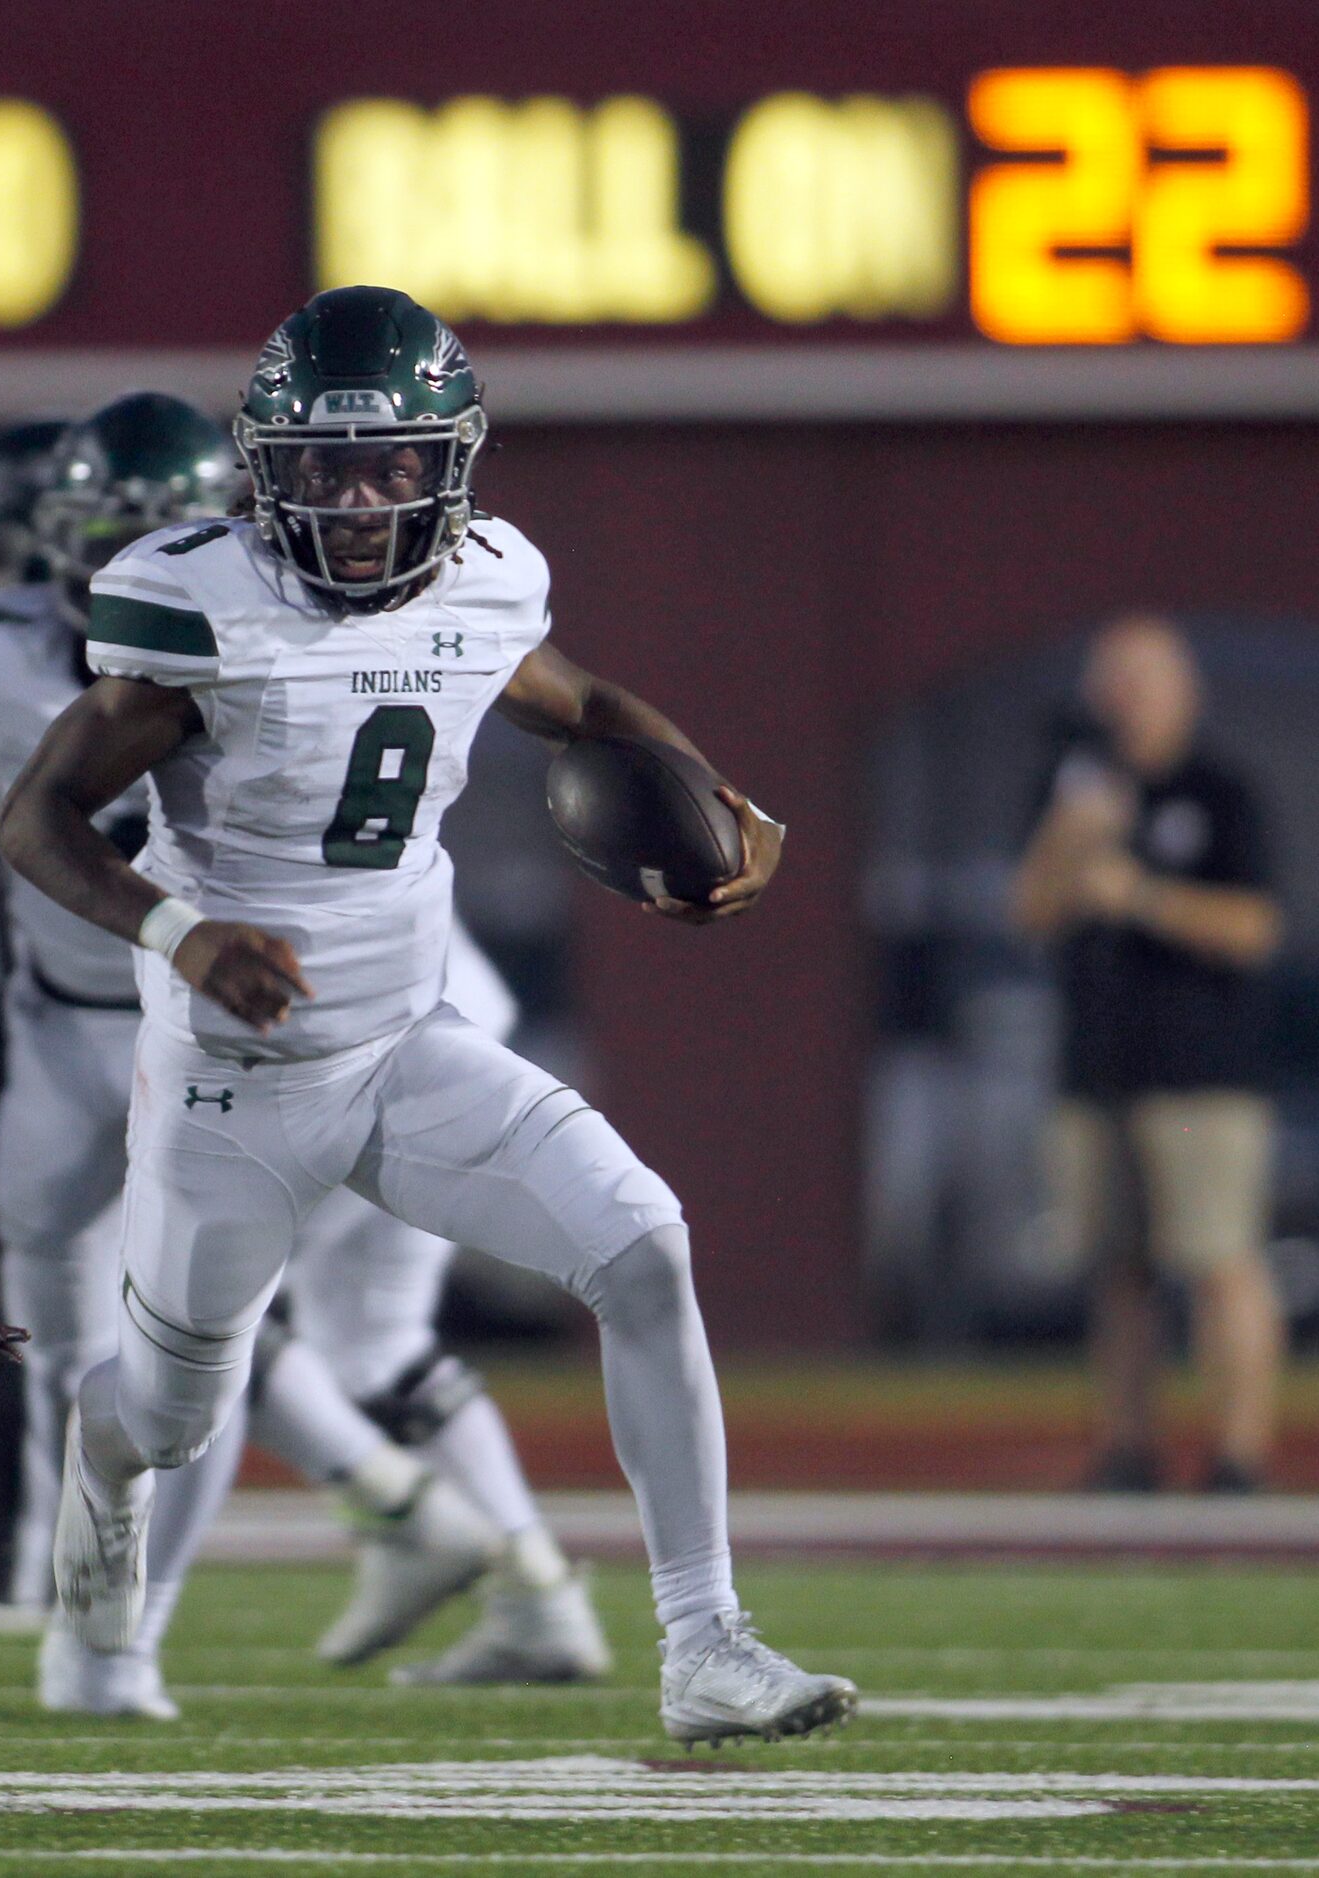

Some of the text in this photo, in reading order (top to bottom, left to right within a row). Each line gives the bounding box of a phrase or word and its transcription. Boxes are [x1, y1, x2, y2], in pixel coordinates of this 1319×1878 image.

[969, 66, 1311, 344] 22
[351, 670, 443, 694] INDIANS
[321, 704, 437, 870] 8
